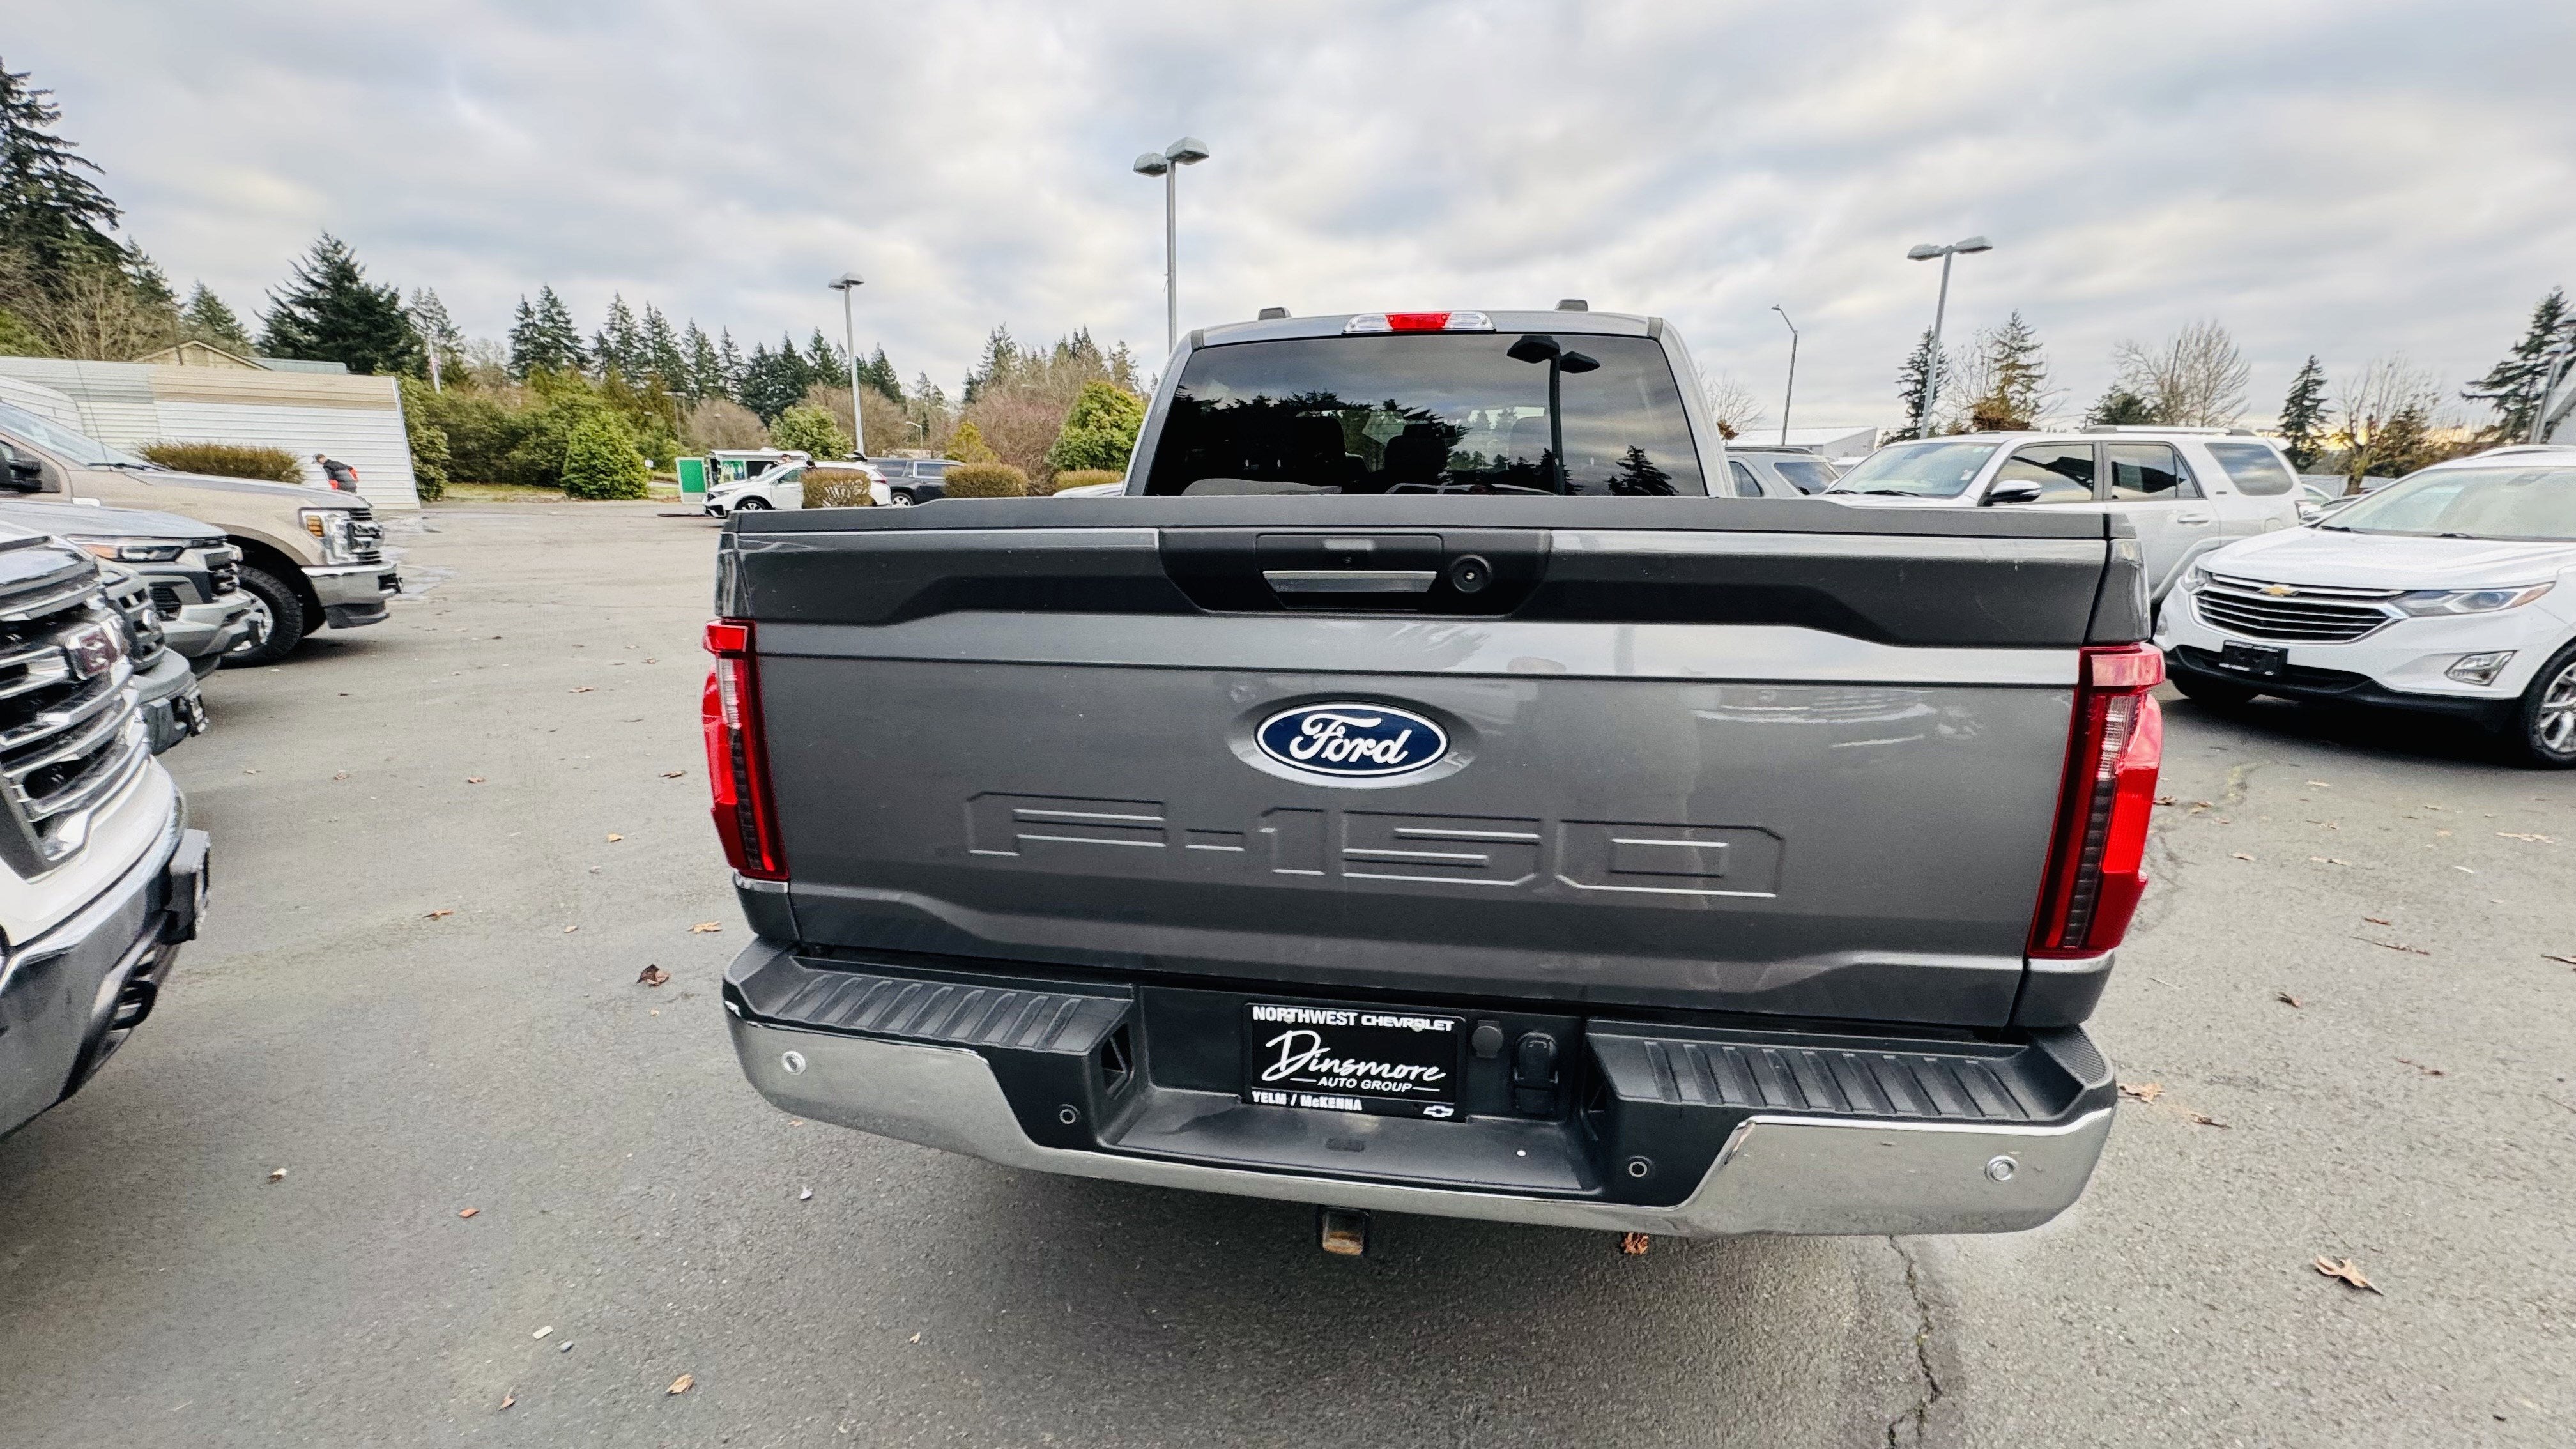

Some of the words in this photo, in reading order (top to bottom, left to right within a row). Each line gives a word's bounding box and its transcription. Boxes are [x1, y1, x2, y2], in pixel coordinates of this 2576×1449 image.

[1289, 713, 1413, 765] Ford
[966, 792, 1785, 898] F-150
[1252, 1006, 1358, 1027] NORTHWEST
[1361, 1015, 1455, 1032] CHEVROLET
[1261, 1030, 1446, 1082] Dinsmore
[1252, 1091, 1287, 1105] YELM
[1300, 1094, 1363, 1111] McKENNA
[1317, 1077, 1358, 1089] AUTO
[1360, 1080, 1413, 1092] GROUP
